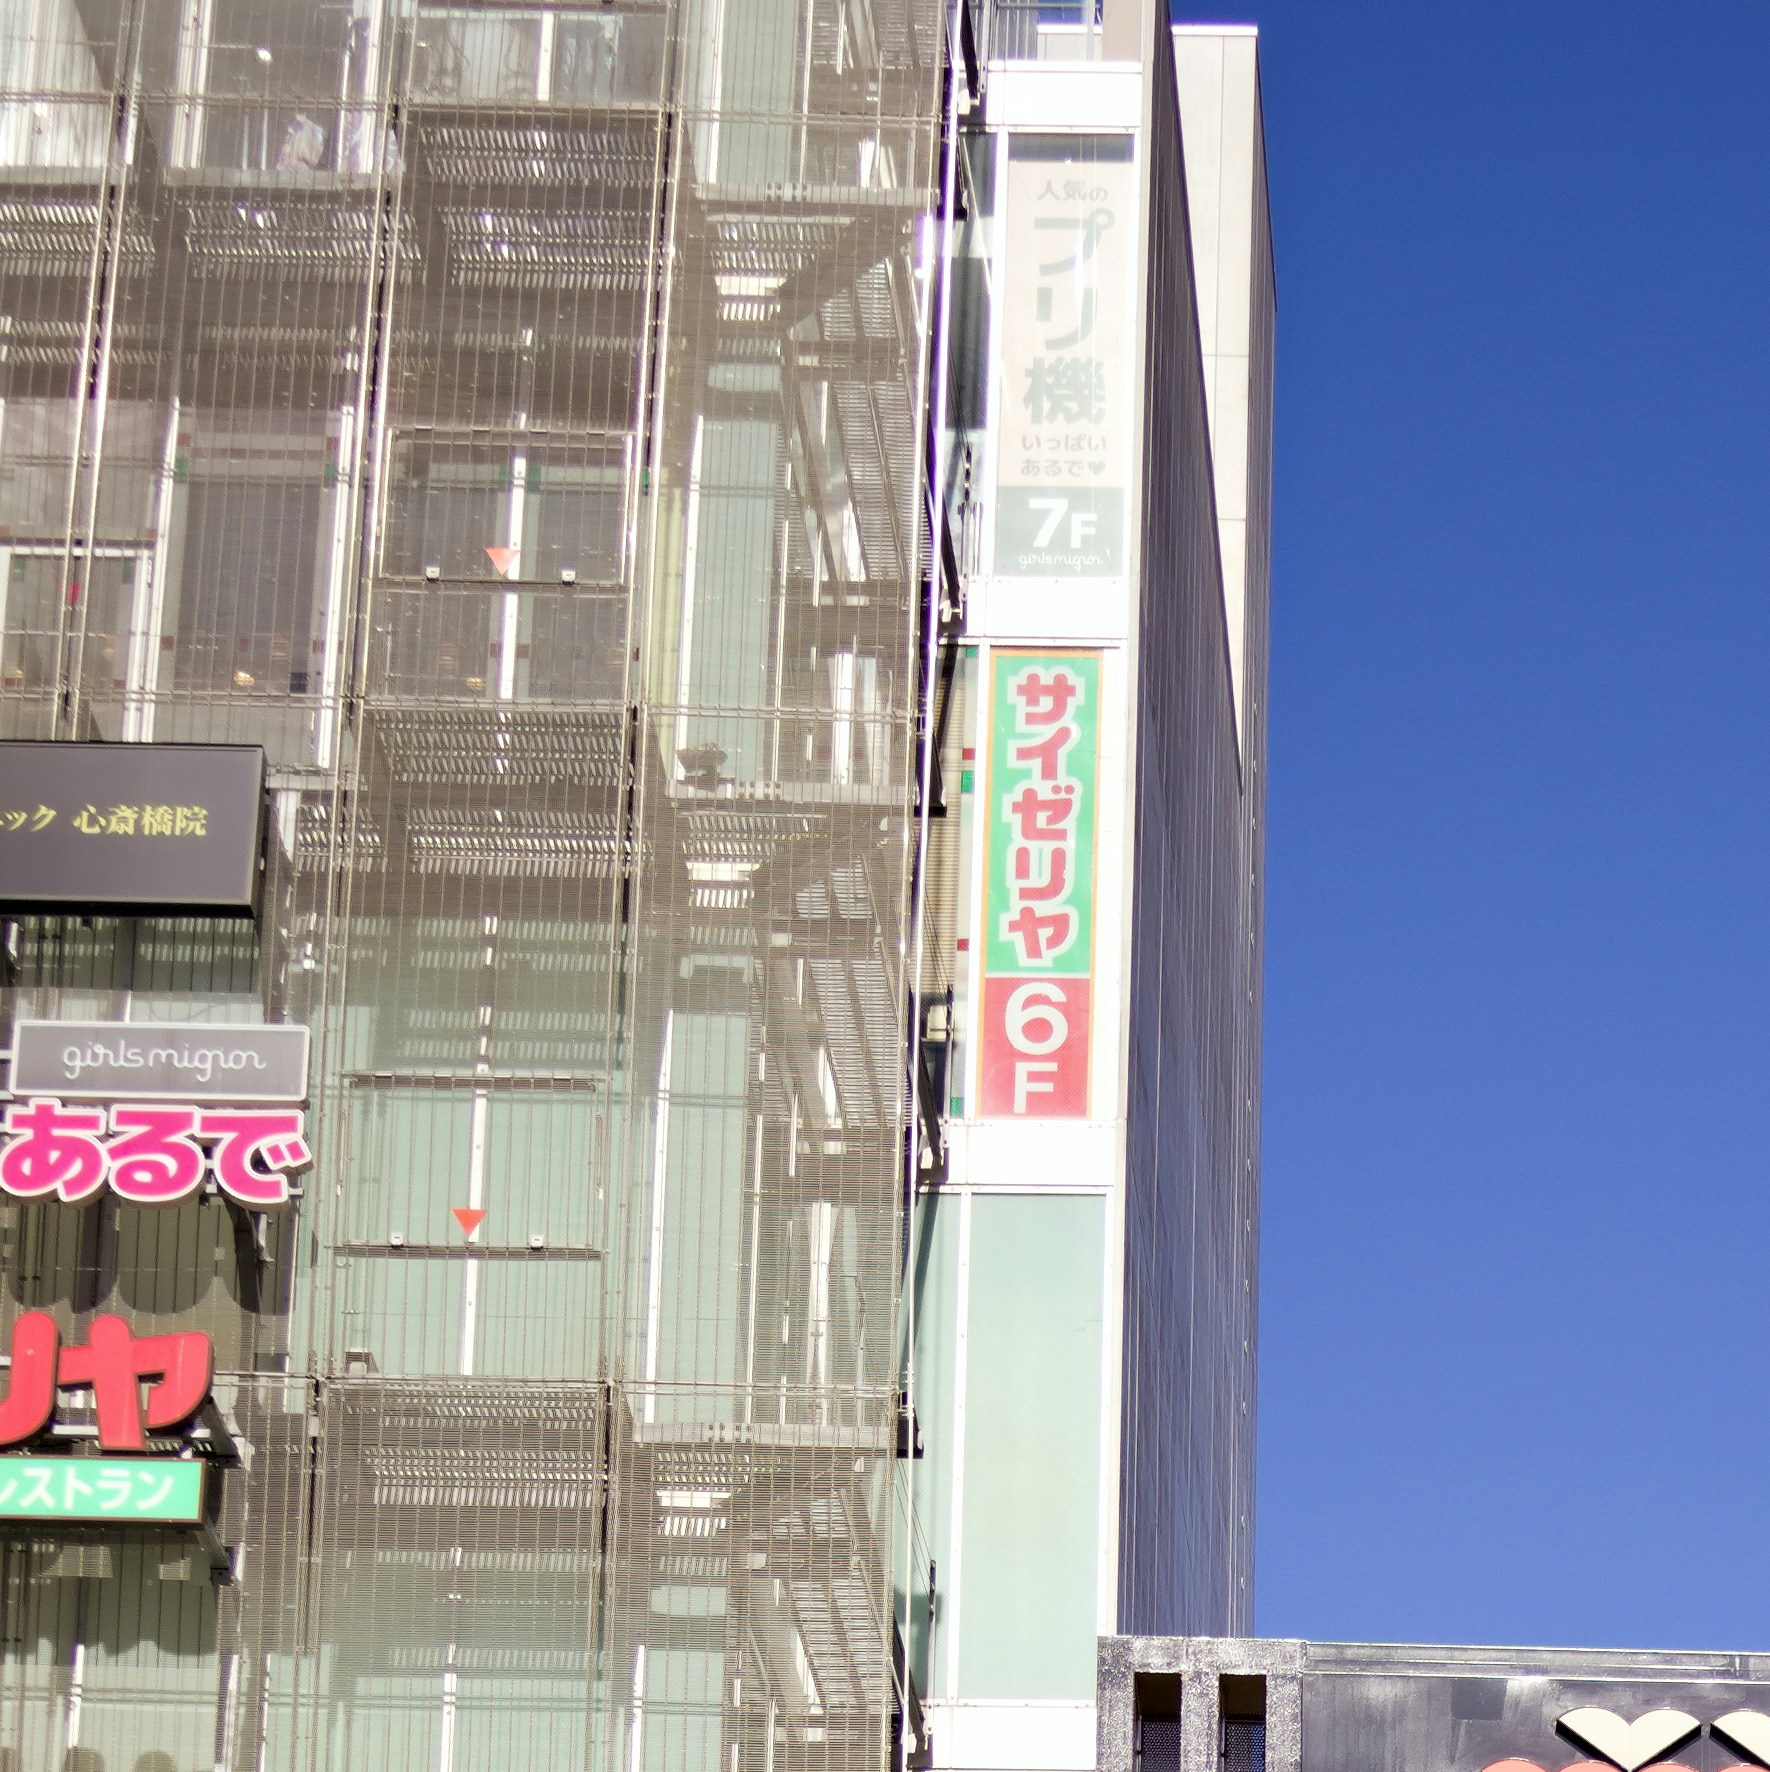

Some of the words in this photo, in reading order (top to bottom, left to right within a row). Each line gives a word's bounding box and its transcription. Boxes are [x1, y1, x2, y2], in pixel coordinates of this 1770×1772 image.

[1036, 179, 1109, 202] 人気の
[1022, 207, 1116, 427] プリ機
[1021, 433, 1108, 453] いっぱい
[1028, 498, 1098, 550] 7F
[0, 803, 58, 832] ック
[72, 803, 209, 837] 心斎橋院
[1005, 667, 1082, 966] サイゼリヤ
[1004, 981, 1069, 1114] 6F
[0, 1097, 314, 1209] あるで
